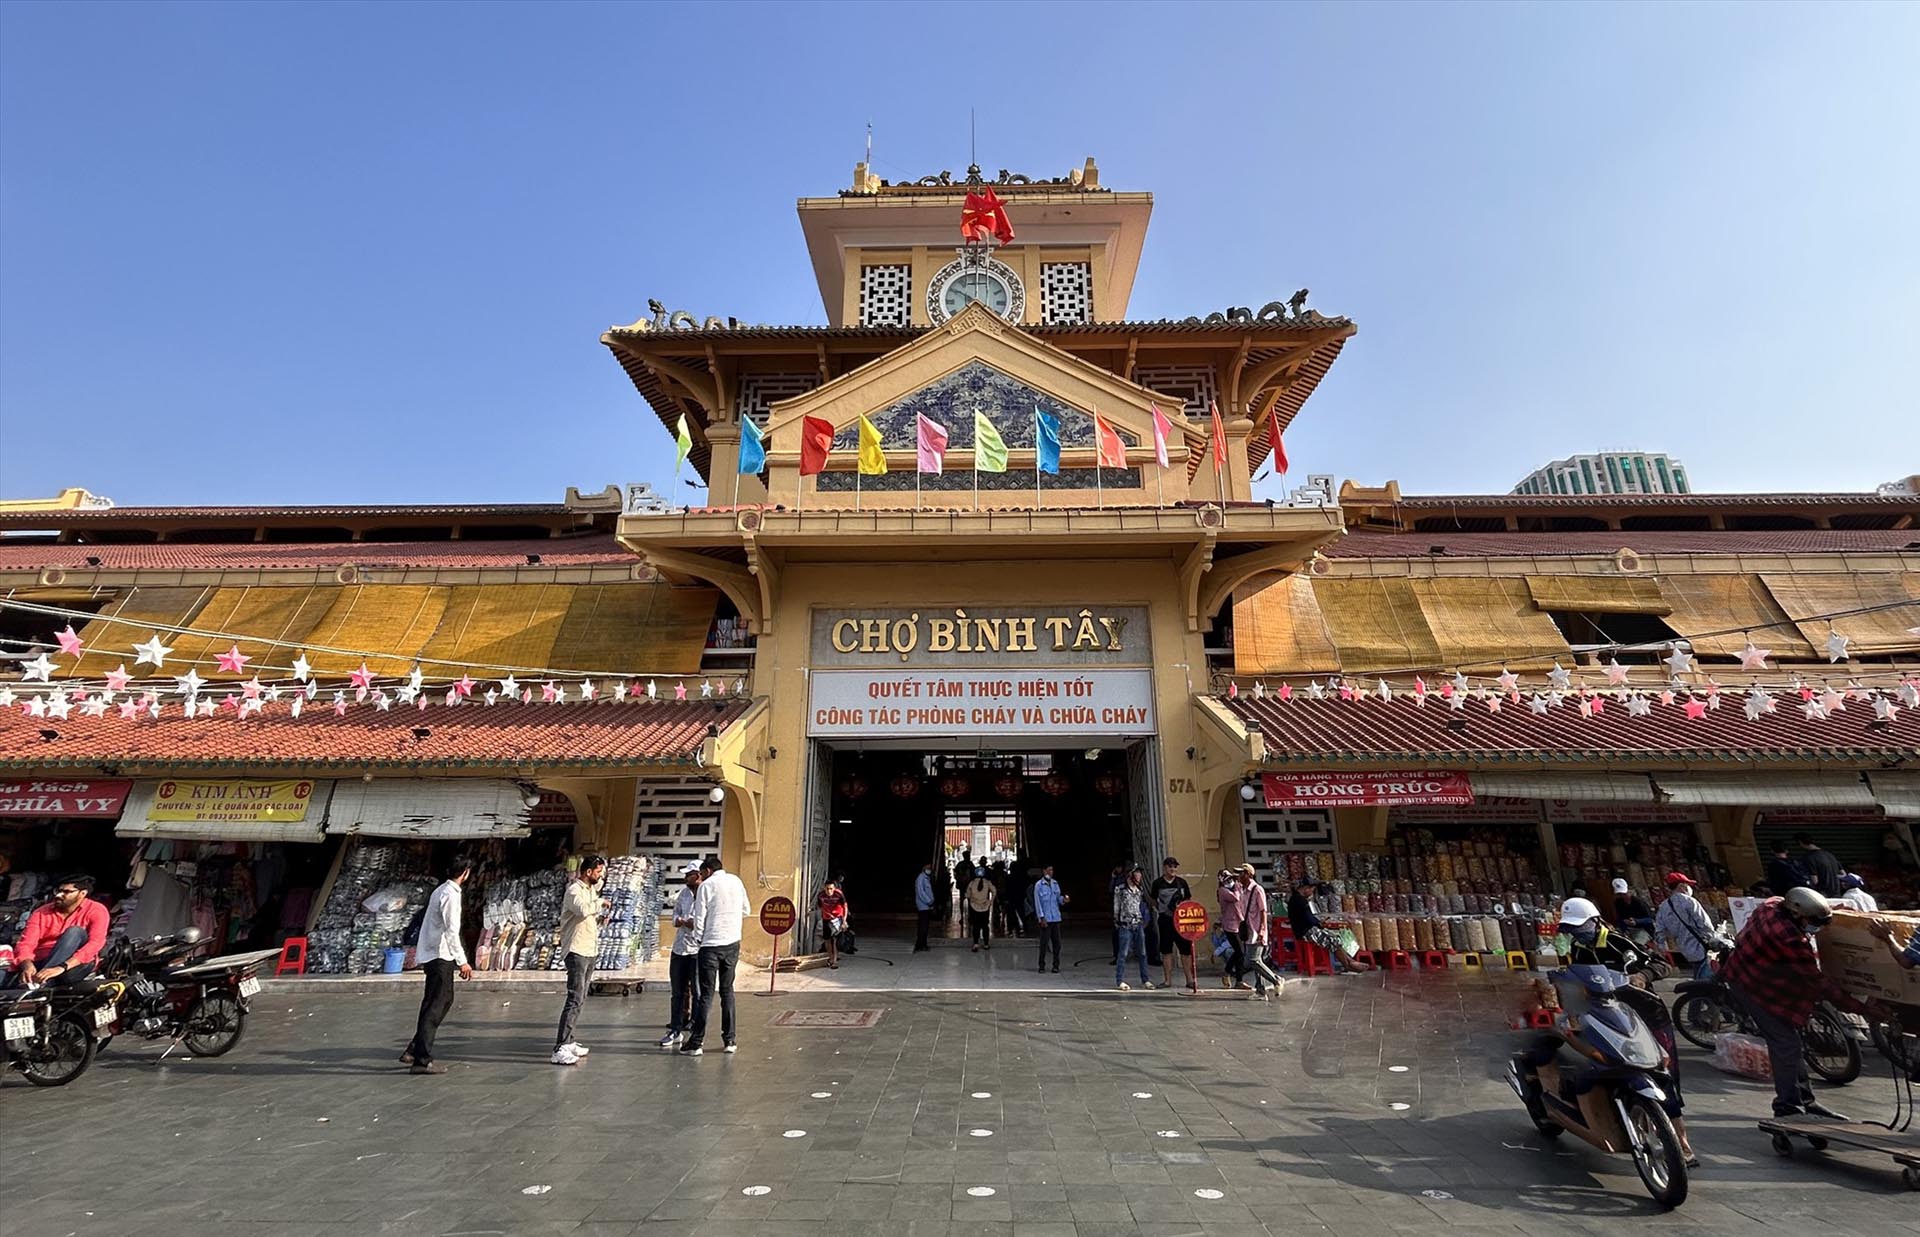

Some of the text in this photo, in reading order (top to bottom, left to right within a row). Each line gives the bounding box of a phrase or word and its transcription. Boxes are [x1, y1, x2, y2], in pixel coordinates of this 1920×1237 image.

[831, 608, 1128, 661] CHỢ BÌNH TÂY
[868, 675, 1094, 701] QUYẾT TÂM THỰC HIỆN TỐT
[816, 703, 1148, 725] CÔNG TÁC PHÒNG CHÁY VÀ CHỮA CHÁY
[1302, 773, 1332, 781] HÀNG
[190, 785, 227, 799] KIM
[1169, 778, 1196, 793] 57A
[1294, 779, 1443, 797] HỒNG TRÚC
[75, 798, 118, 812] VY
[1178, 905, 1204, 918] CẤM
